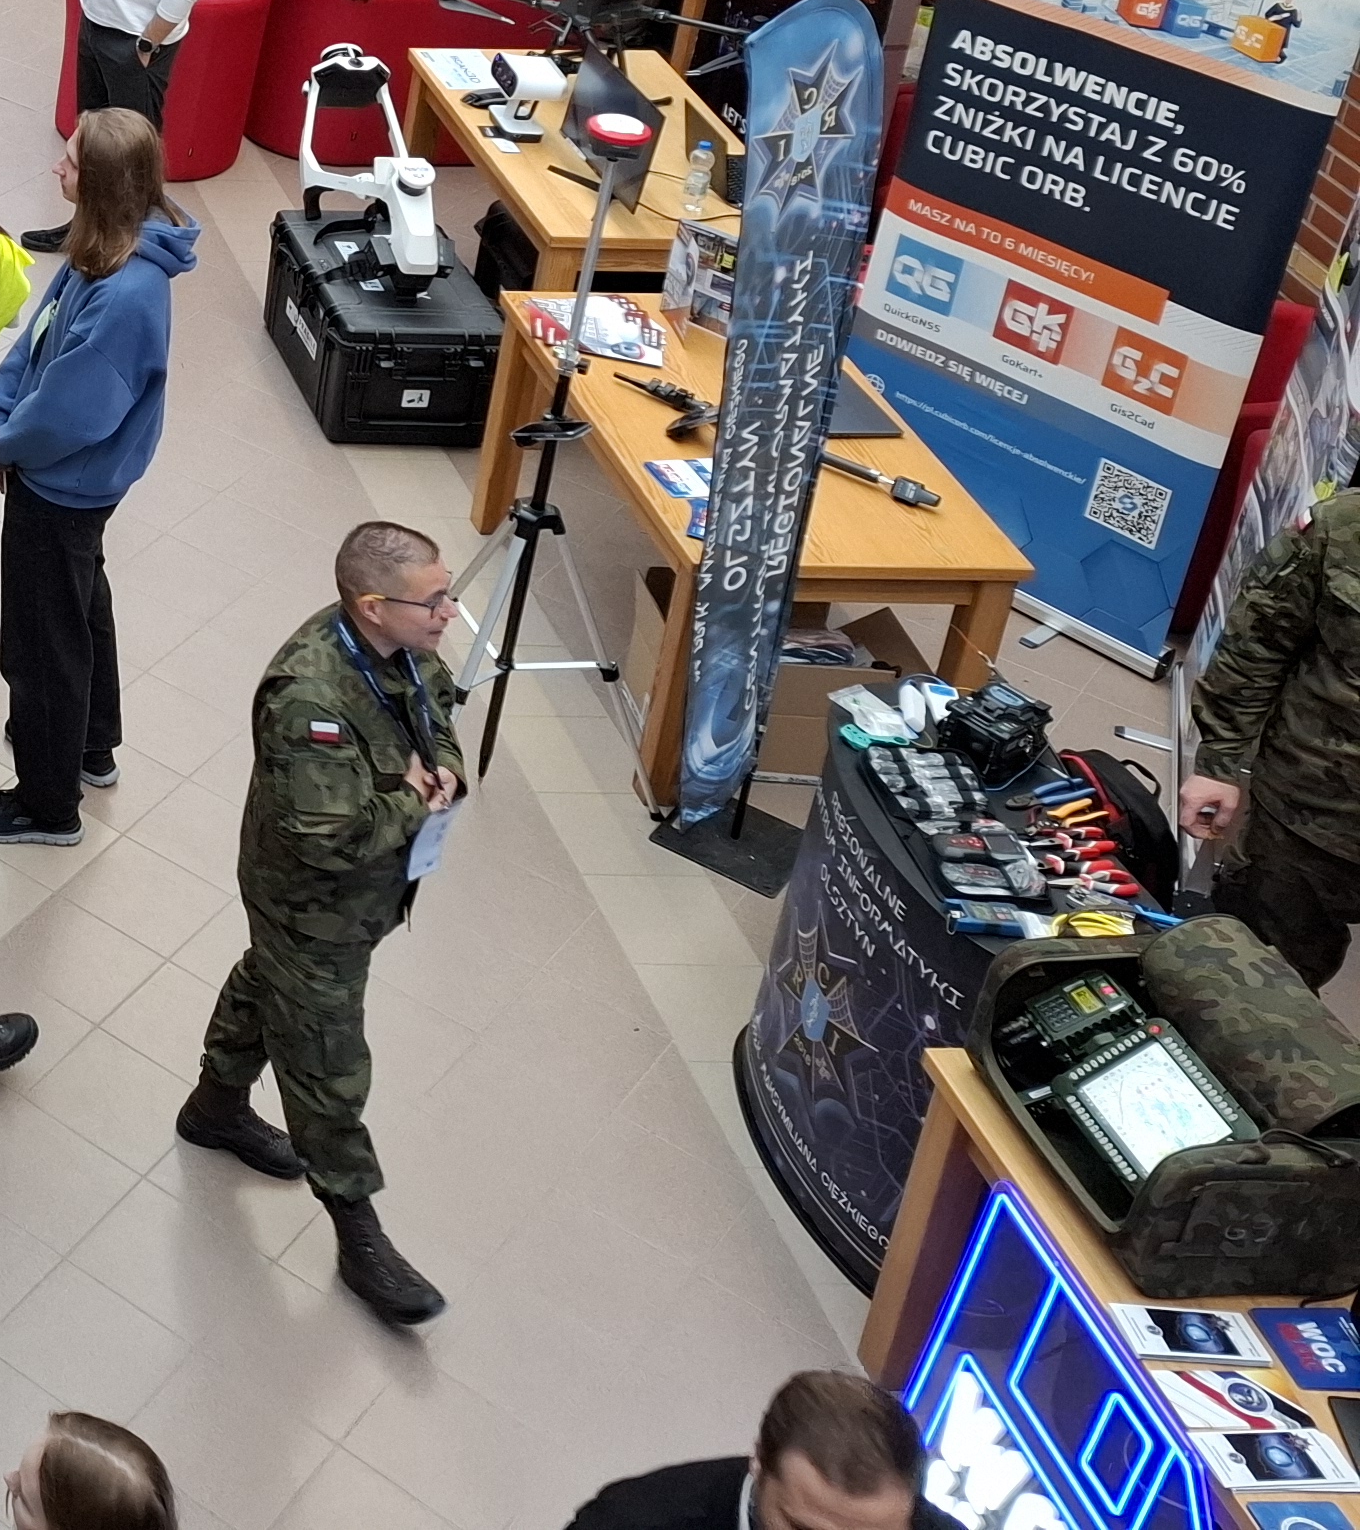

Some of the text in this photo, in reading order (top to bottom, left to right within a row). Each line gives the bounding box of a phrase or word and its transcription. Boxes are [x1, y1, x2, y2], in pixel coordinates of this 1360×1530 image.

[951, 28, 1186, 136] ABSOLWENCIE,
[933, 95, 1242, 233] ZNIŻKI NA LICENCJE
[945, 62, 1248, 195] SKORZYSTAJ Z 60%
[925, 129, 1092, 213] CUBIC ORB.
[908, 197, 1096, 286] MASZ NA TO 6 MIESIĘCY!
[882, 302, 942, 333] QuickGNSS
[876, 328, 1029, 405] DOWIEDZ SIĘ WIĘCEJ
[1001, 353, 1044, 380] GoKart+
[1110, 401, 1156, 431] Gis2Cad
[831, 791, 907, 922] REGIONALNE
[837, 855, 966, 1011] INFORMATYKI
[820, 1169, 890, 1252] CIĘŻKIEGO
[1297, 1321, 1347, 1374] WOC
